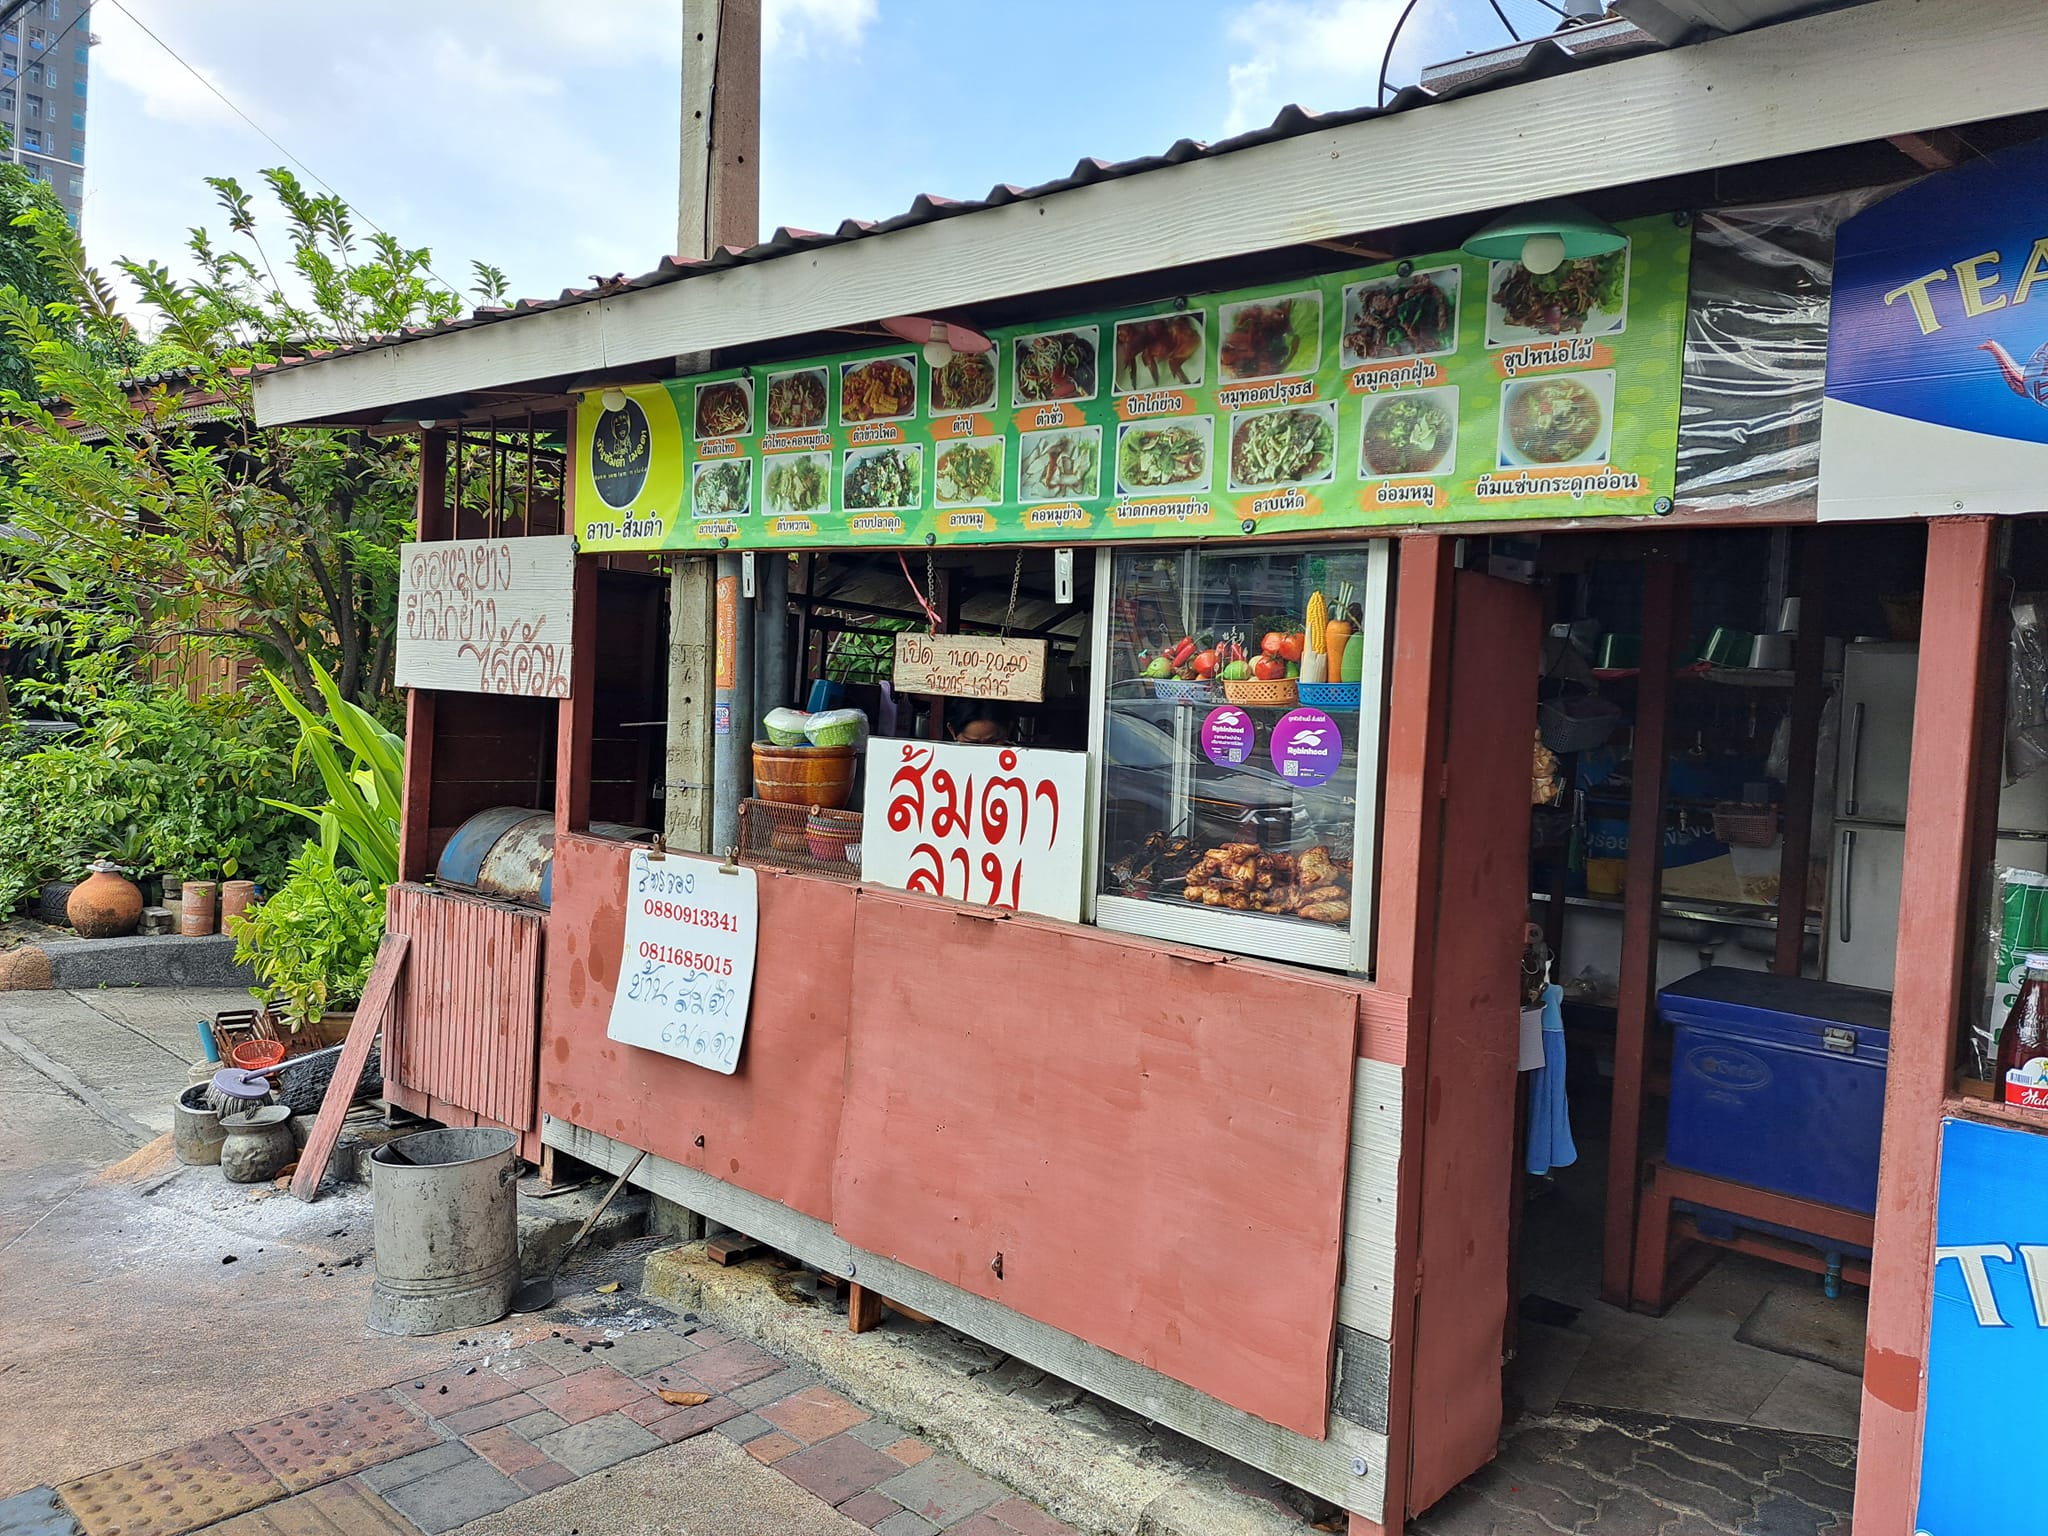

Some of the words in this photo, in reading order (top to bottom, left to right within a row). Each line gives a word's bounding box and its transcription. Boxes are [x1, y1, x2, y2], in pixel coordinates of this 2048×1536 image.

[1353, 360, 1435, 391] หมูคลุกฝุ่น
[1127, 392, 1182, 414] ปีกไก่ย่าง
[1220, 381, 1313, 409] หมูทอดปรุงรส
[952, 416, 974, 437] ตำปู
[1377, 484, 1434, 506] อ่อมหมู
[1476, 468, 1638, 497] ต้มแซ่บกระดูกอ่อน
[1117, 496, 1209, 521] น้ำตกคอหมูย่าง
[1253, 488, 1304, 513] ลาบเห็ด
[586, 511, 664, 541] ลาบ-ส้มตำ
[776, 516, 810, 531] ตับหวาน
[853, 517, 901, 533] ลาบปลาดุก
[950, 513, 984, 529] ลาบหมู
[1031, 506, 1082, 527] คอหมูย่าง
[902, 637, 933, 665] เปิด
[1287, 746, 1328, 756] Robinhood
[887, 744, 1060, 852] ส้มตำ
[643, 898, 738, 933] 0880913341
[639, 941, 733, 976] 0811685015
